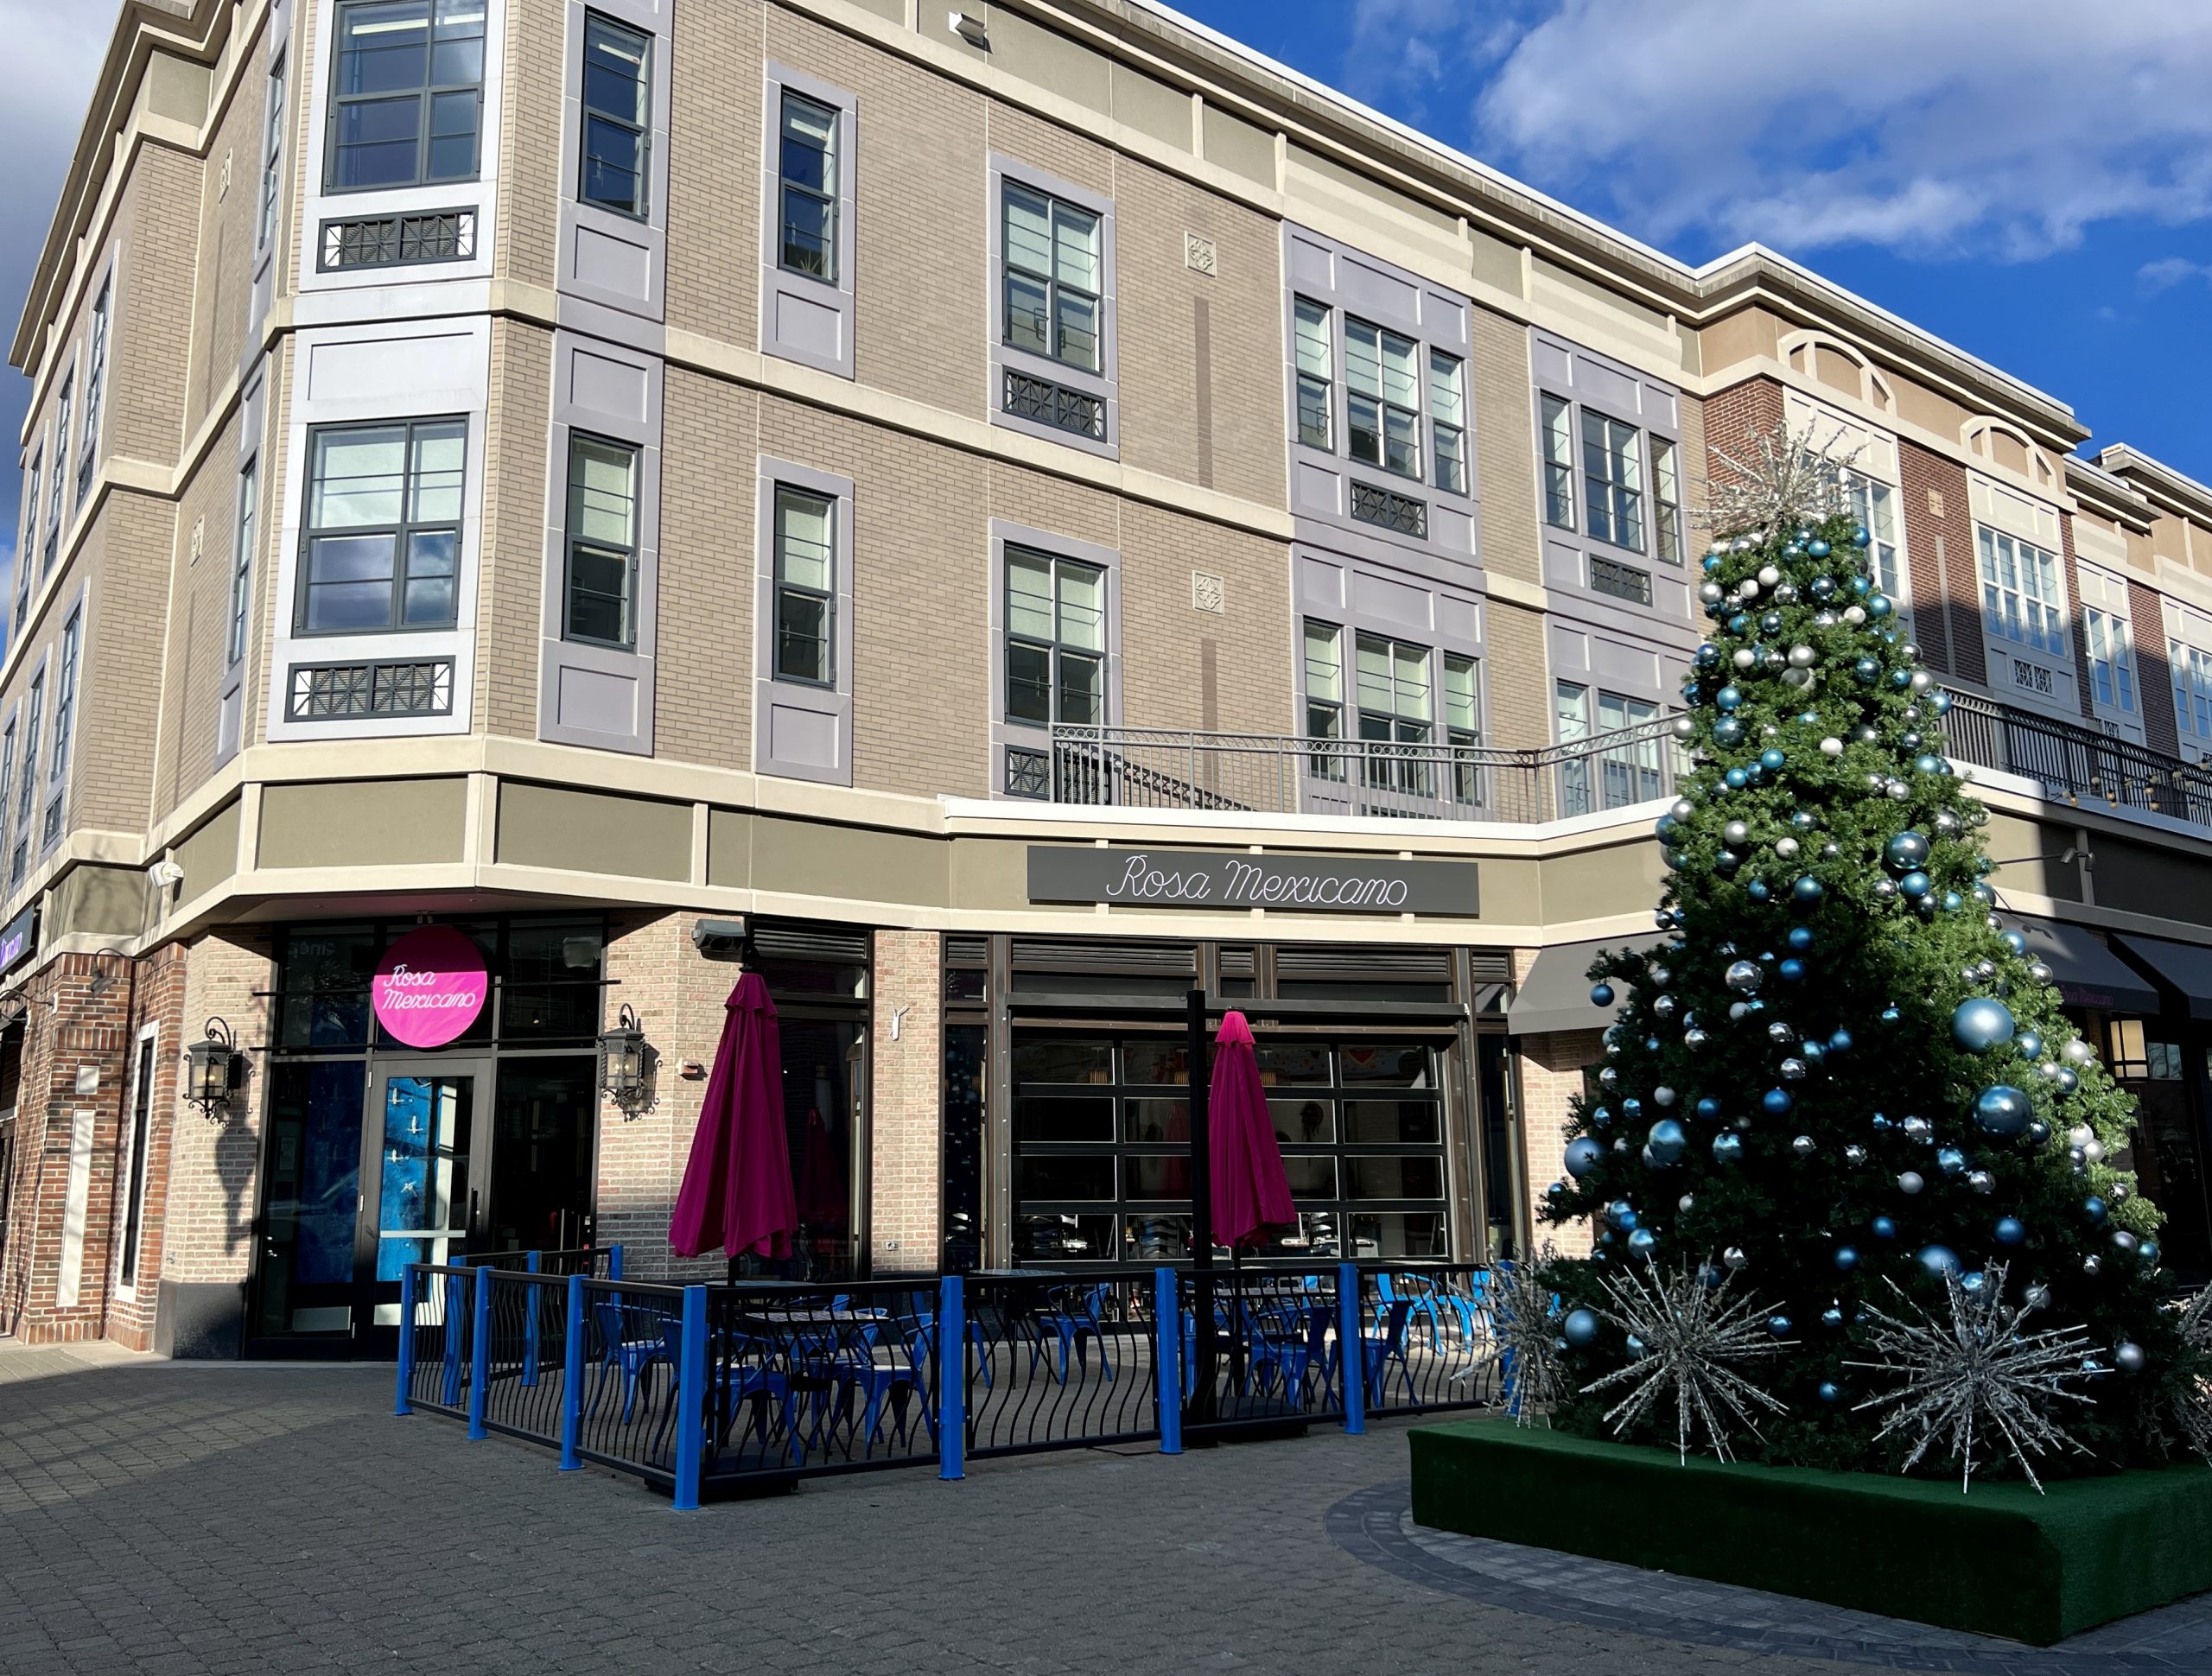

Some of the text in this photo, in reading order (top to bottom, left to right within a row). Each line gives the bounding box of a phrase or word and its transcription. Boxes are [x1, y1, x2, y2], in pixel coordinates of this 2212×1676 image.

[1105, 854, 1408, 907] Rosa Mexicano
[383, 963, 436, 987] Rosa
[382, 988, 476, 1010] Mexicano
